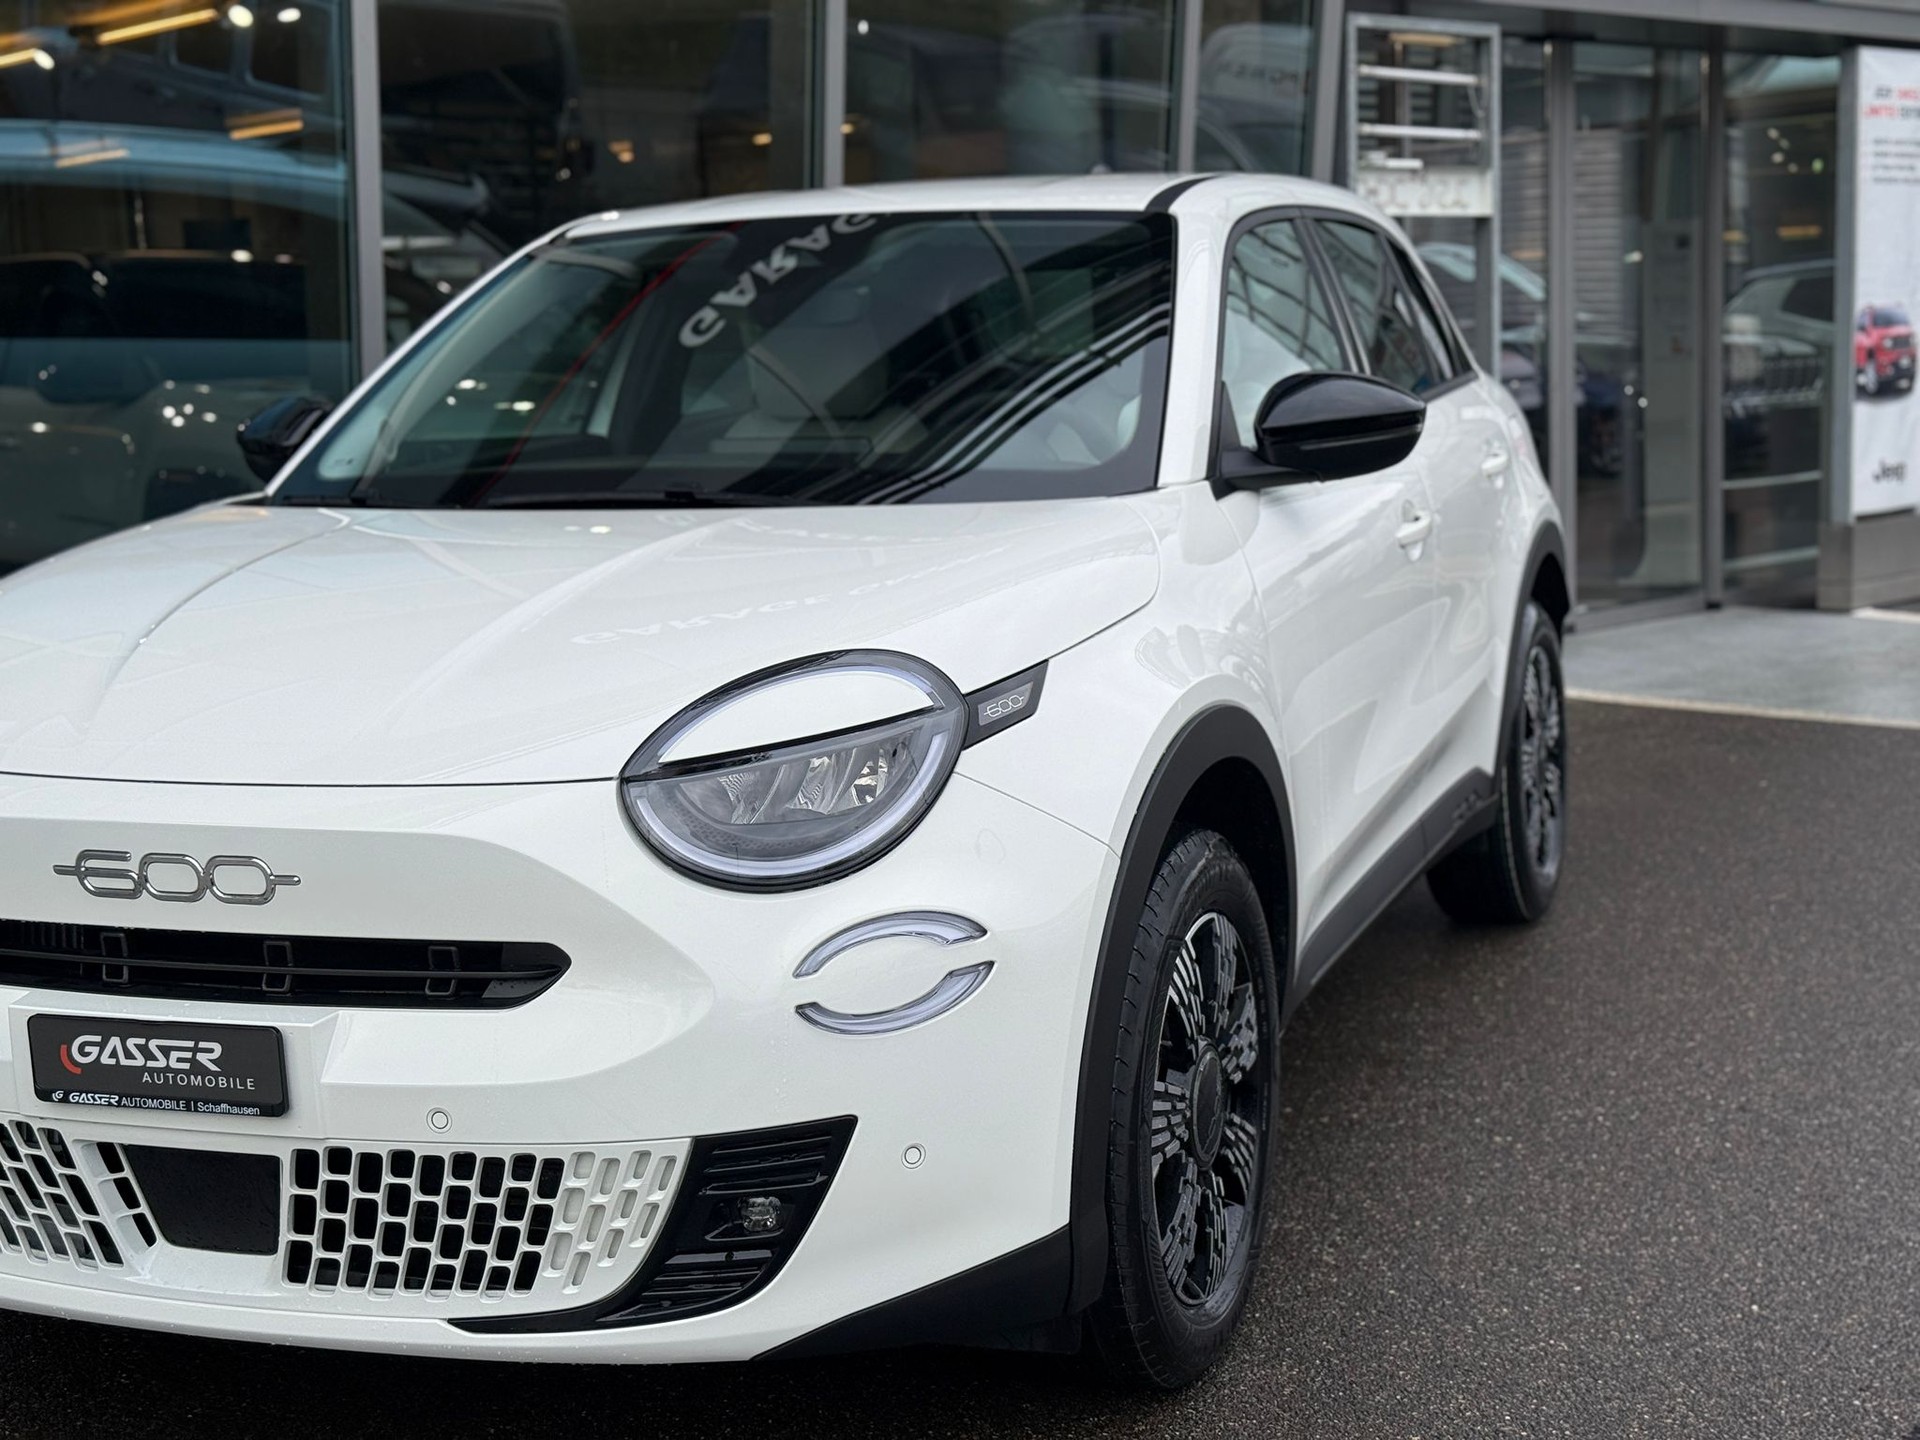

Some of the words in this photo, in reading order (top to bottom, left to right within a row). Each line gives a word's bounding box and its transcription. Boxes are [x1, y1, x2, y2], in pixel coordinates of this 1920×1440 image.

[986, 694, 1023, 718] 600
[70, 848, 280, 906] 600
[71, 1035, 223, 1072] GASSER
[141, 1071, 256, 1091] AUTOMOBILE
[69, 1092, 119, 1107] GASSER
[120, 1097, 187, 1112] AUTOMOBILE
[197, 1101, 261, 1117] Schaffhausen
